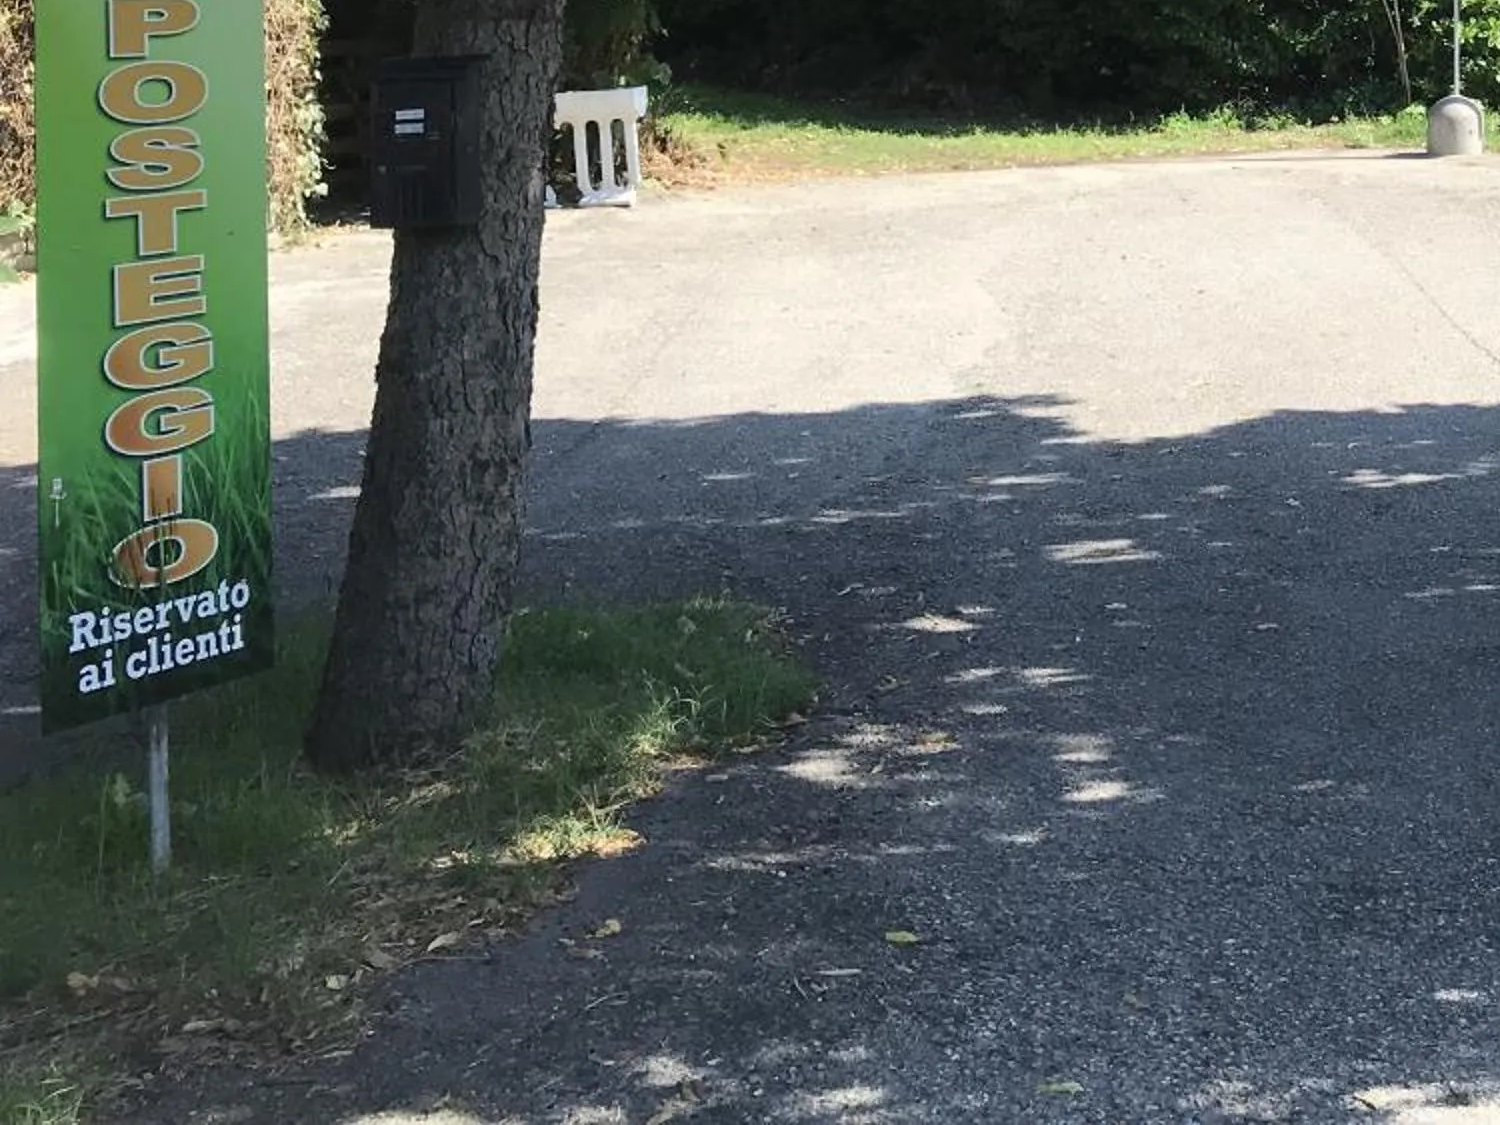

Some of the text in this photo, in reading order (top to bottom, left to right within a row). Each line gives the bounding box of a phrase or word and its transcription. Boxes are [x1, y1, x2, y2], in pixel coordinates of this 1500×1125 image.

[68, 578, 251, 654] Riservato
[78, 615, 245, 693] ai clienti
